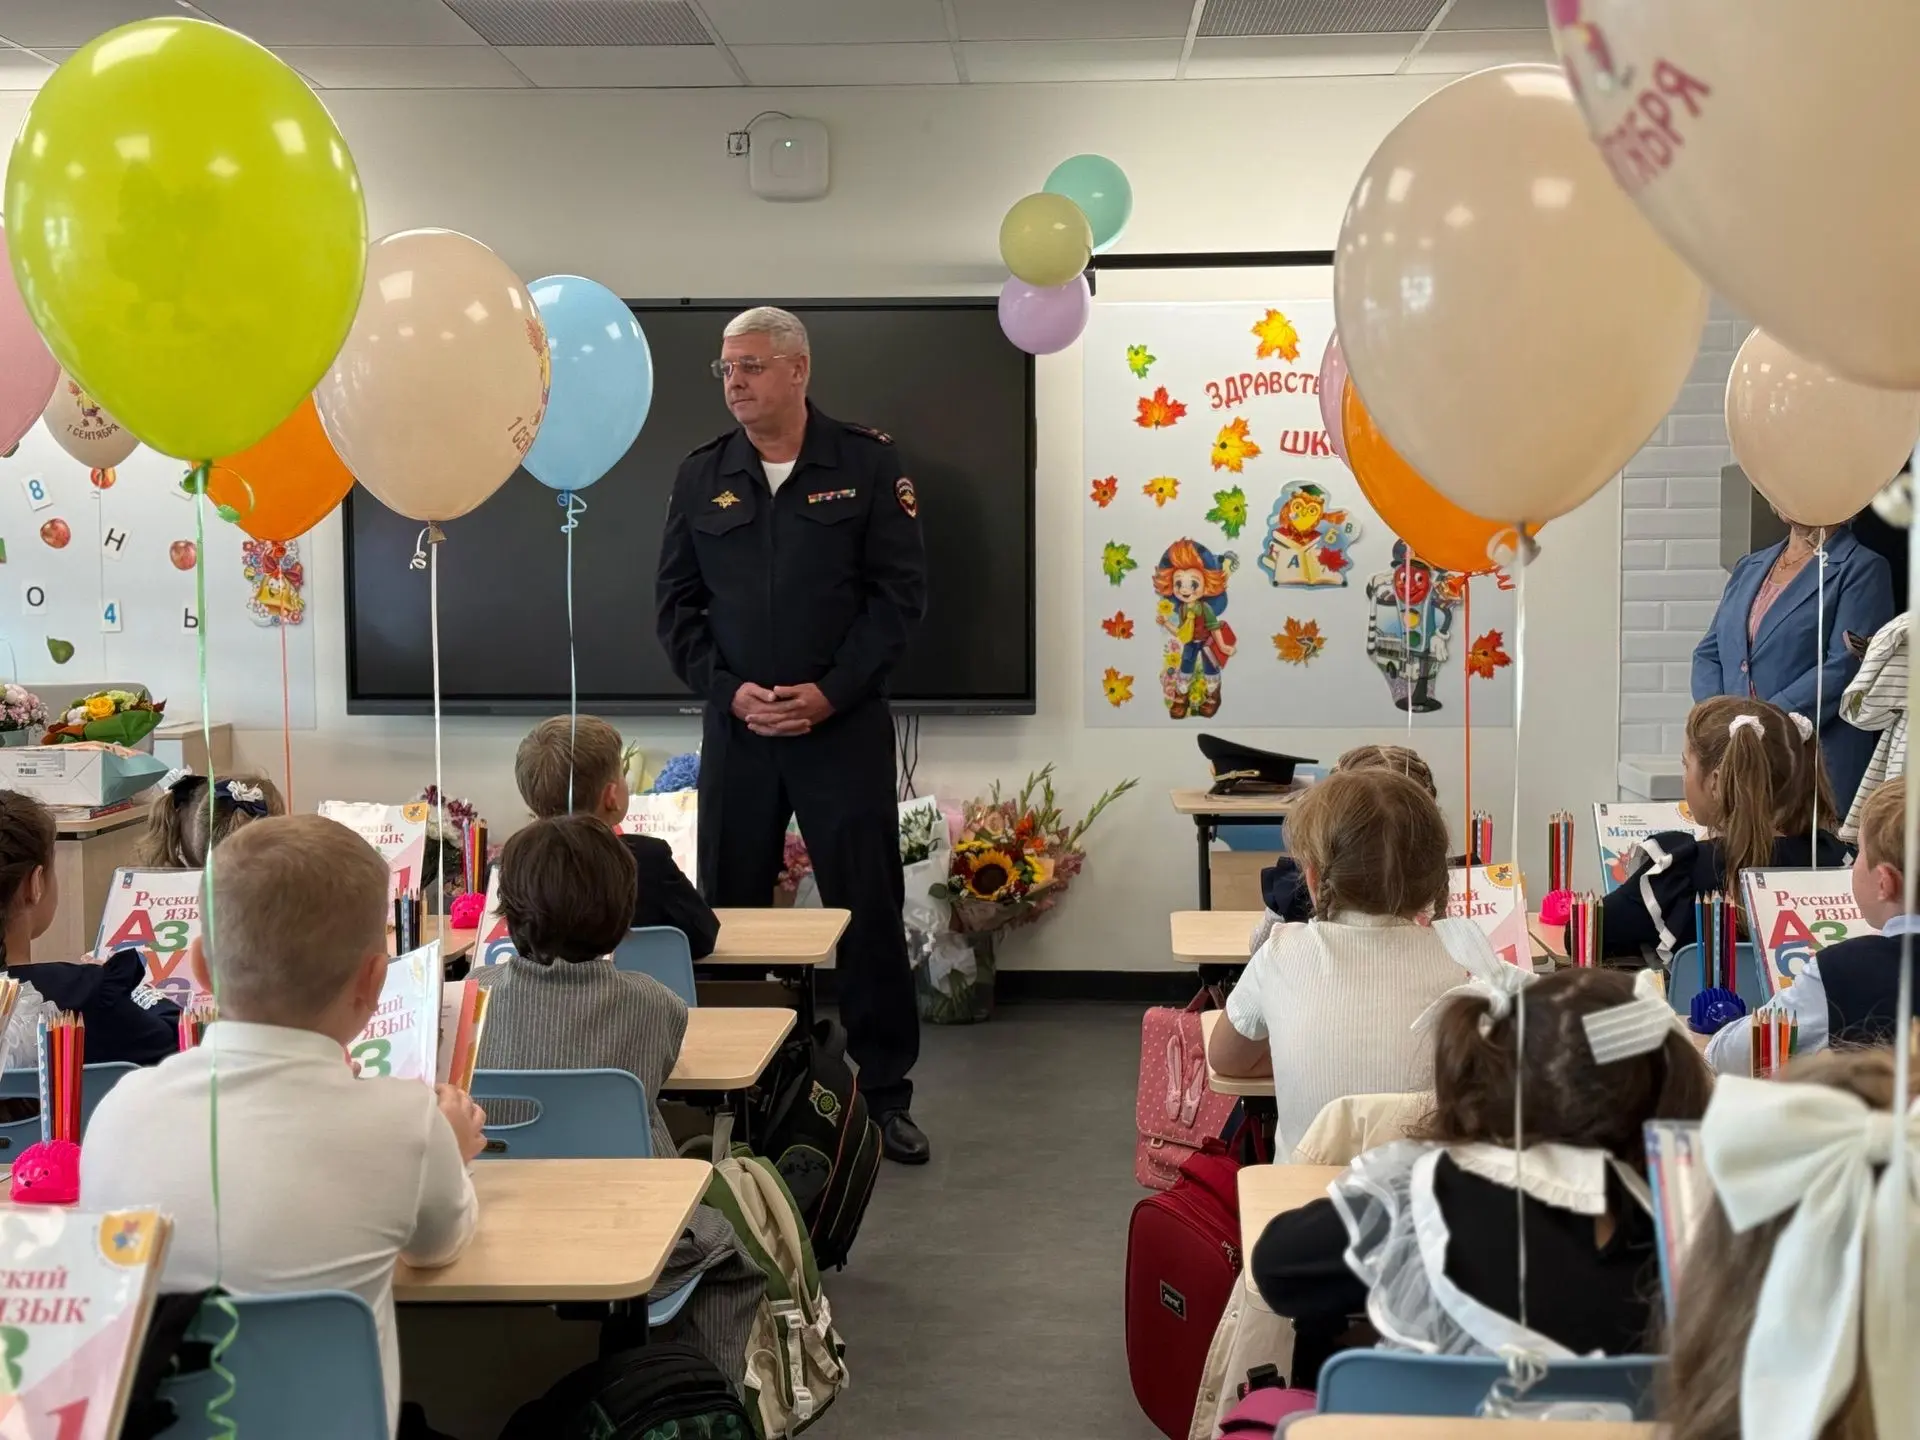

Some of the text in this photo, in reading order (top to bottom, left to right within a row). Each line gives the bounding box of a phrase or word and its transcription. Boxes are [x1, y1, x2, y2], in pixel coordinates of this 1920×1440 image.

[73, 422, 120, 440] СЕНТЯБРЯ
[1279, 430, 1338, 456] ШК
[28, 479, 44, 500] 8
[104, 528, 126, 551] Н
[104, 603, 116, 623] 4
[1773, 890, 1853, 910] Русский
[1814, 907, 1865, 921] ЯЗЫ
[0, 1265, 68, 1289] кий
